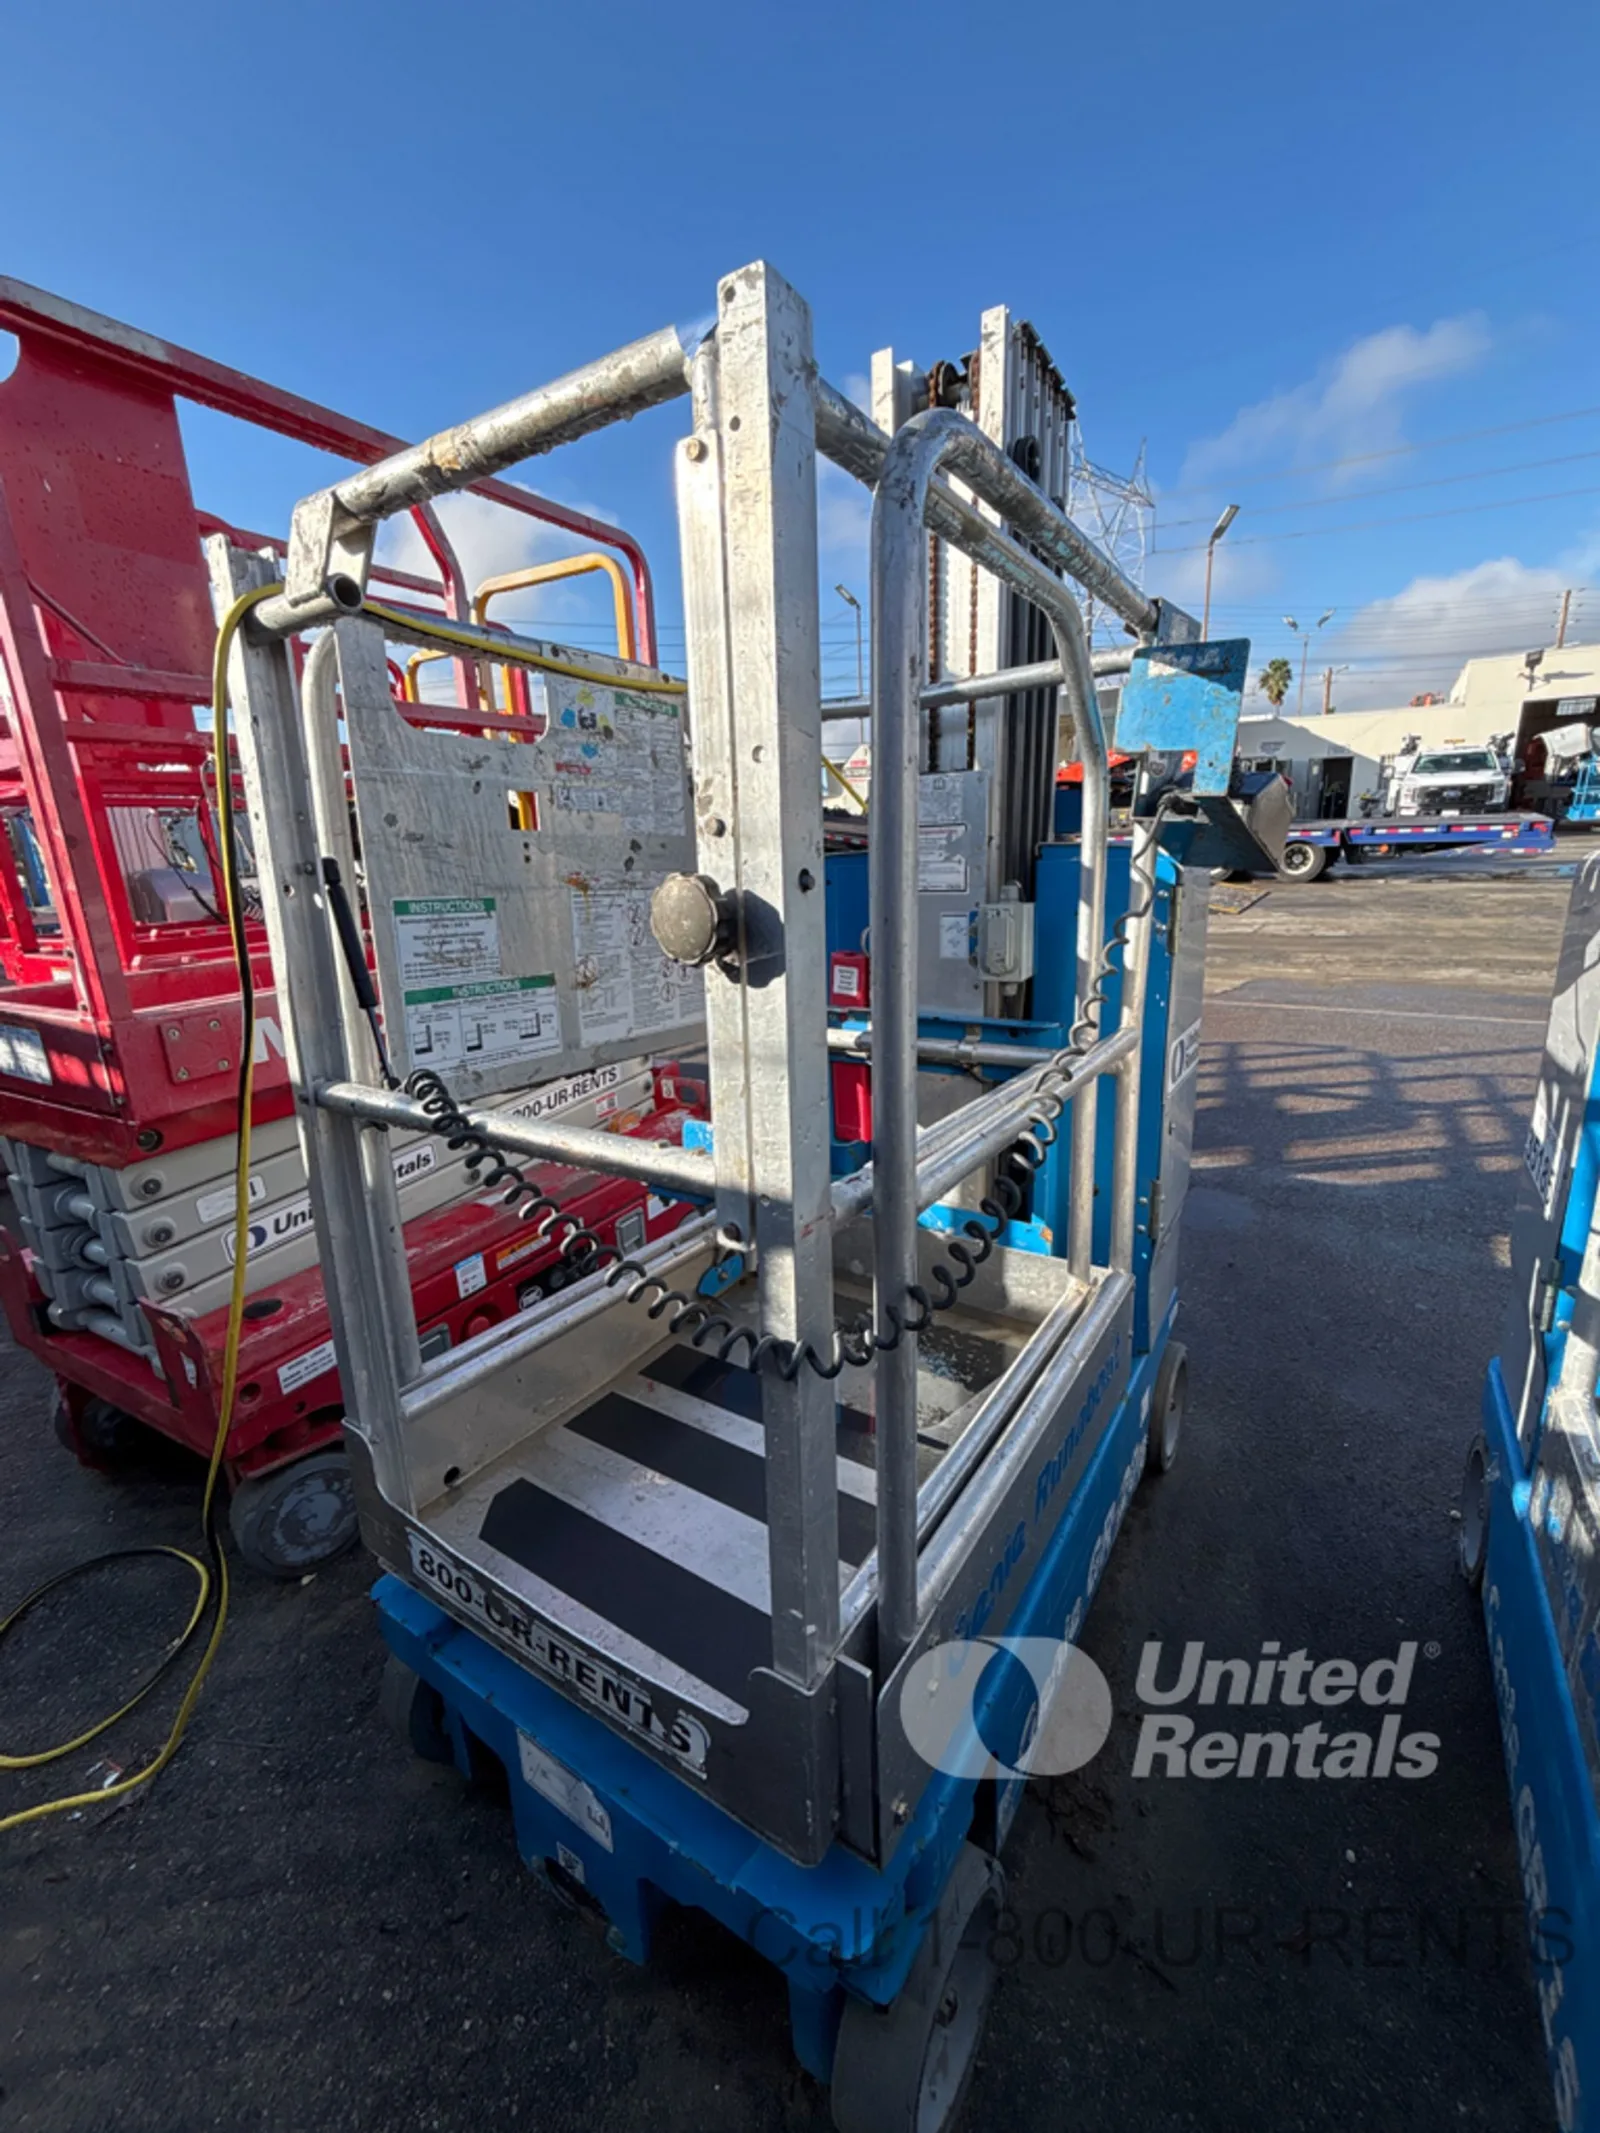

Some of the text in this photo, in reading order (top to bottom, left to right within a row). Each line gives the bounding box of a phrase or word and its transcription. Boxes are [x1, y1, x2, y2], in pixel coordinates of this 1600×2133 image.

[408, 900, 485, 913] INSTRUCTIONS
[452, 981, 521, 997] INSTRUCTIONS
[274, 1153, 432, 1235] Uni tals
